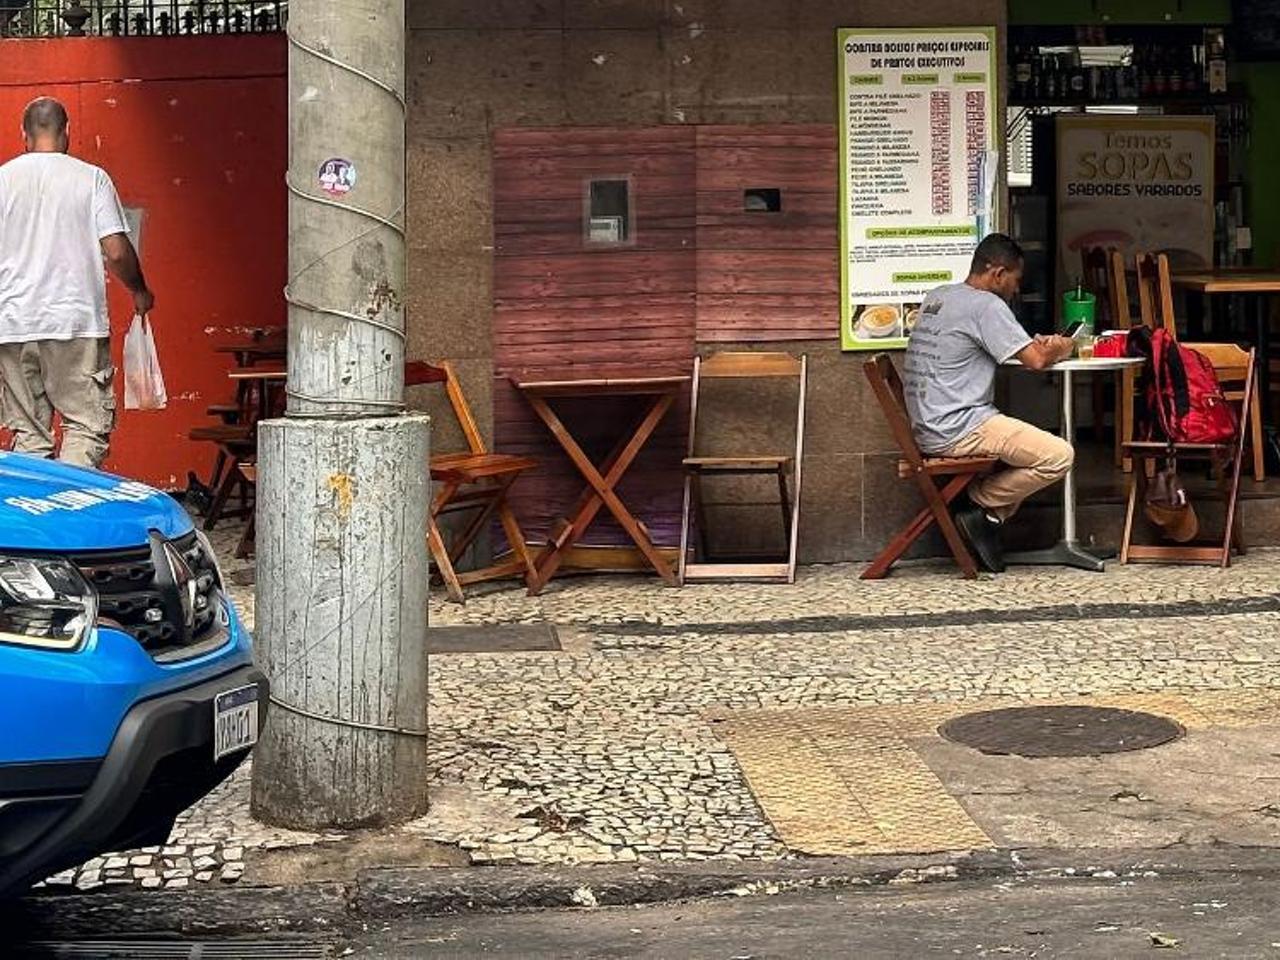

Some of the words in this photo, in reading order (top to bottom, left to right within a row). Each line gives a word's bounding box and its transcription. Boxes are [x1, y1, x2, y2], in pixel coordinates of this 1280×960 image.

[1104, 131, 1171, 148] Temos
[1077, 151, 1192, 180] SOPAS
[1068, 183, 1130, 197] SABORES
[1135, 183, 1202, 197] VARIADOS
